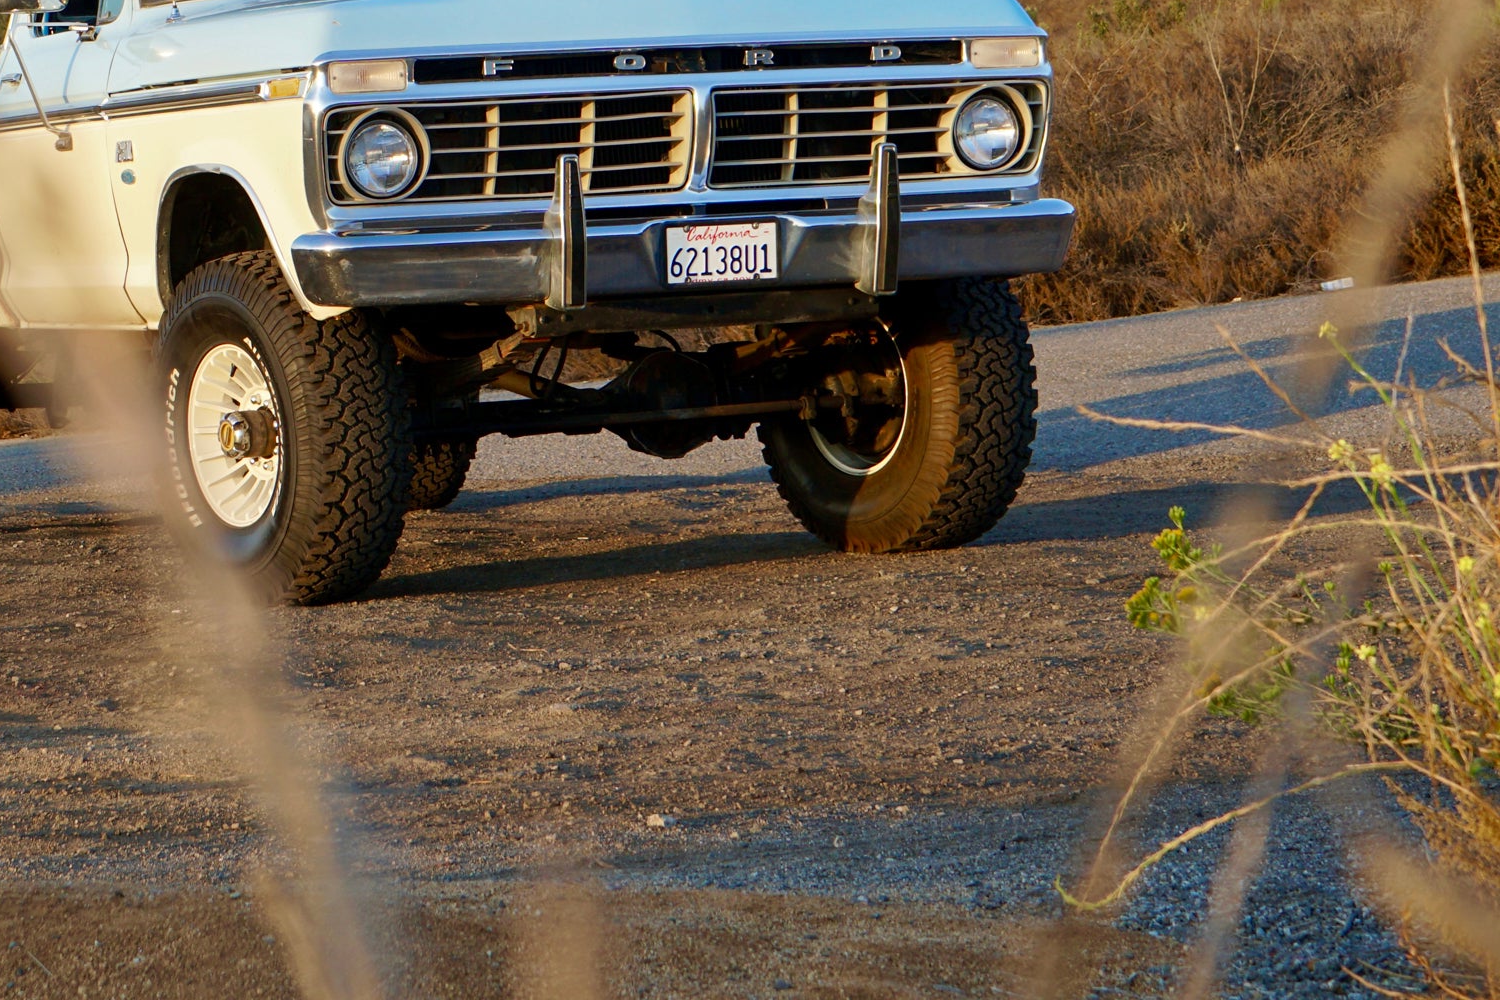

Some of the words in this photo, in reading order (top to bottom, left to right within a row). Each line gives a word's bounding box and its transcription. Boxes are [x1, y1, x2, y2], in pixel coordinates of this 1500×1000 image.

[482, 45, 902, 77] FORD
[686, 225, 759, 245] California
[670, 243, 773, 278] 62138U1
[164, 367, 203, 529] BFGoodrich
